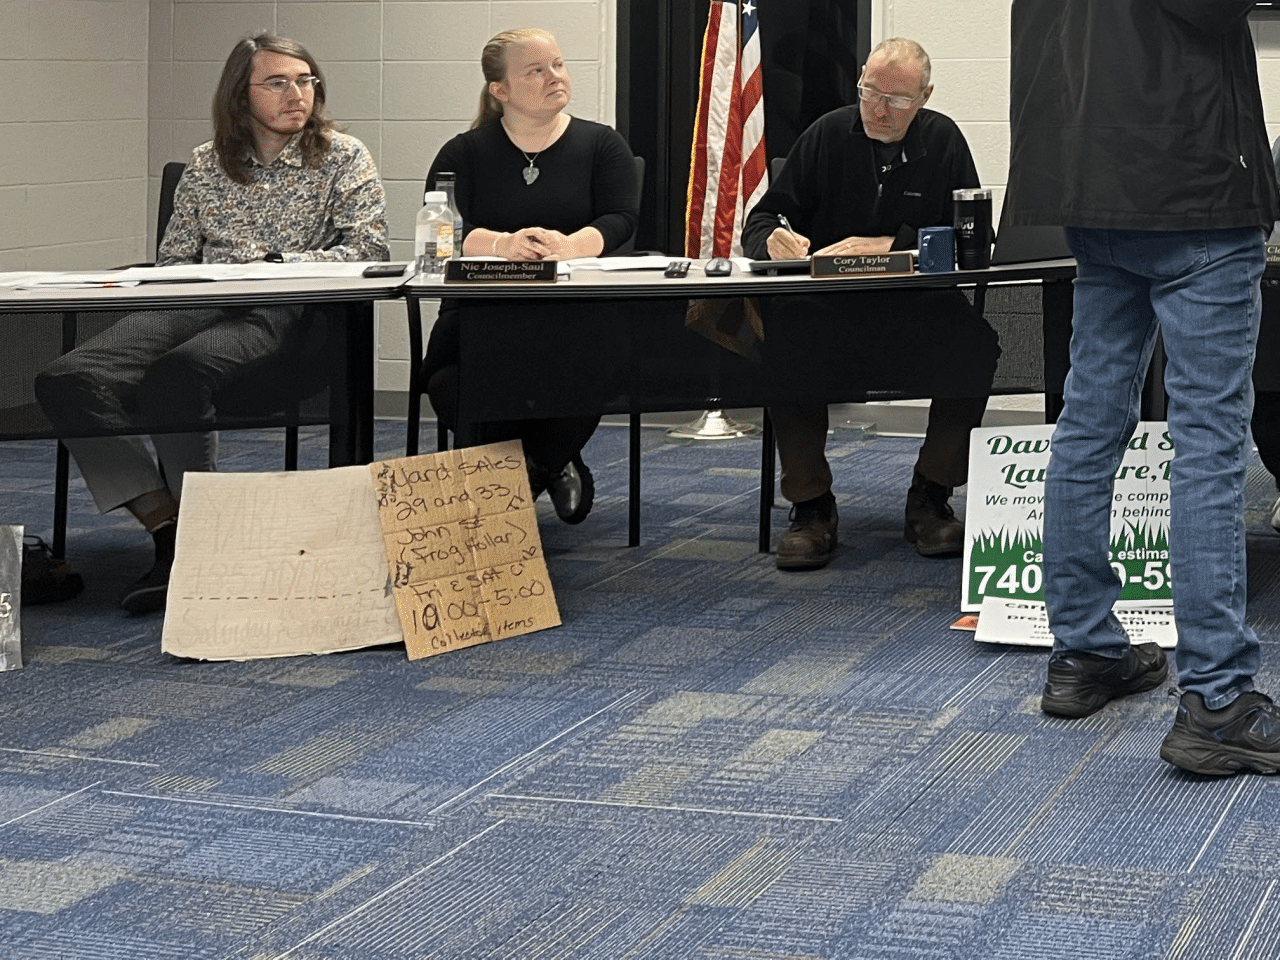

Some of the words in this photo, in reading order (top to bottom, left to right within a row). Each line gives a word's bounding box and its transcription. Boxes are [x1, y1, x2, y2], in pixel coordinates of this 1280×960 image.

[460, 262, 480, 271] Nic
[482, 262, 544, 273] Joseph-Saul
[833, 256, 857, 267] Cory
[860, 256, 891, 266] Taylor
[838, 265, 886, 274] Councilman
[466, 272, 537, 280] Councilmember
[987, 435, 1050, 455] Dav
[392, 462, 451, 496] Yard
[396, 498, 427, 520] 29
[434, 490, 469, 507] and
[475, 484, 511, 500] 33
[986, 494, 1008, 505] We
[1127, 492, 1169, 504] comp
[397, 524, 451, 544] John
[1023, 550, 1044, 563] Ca
[1117, 547, 1169, 560] estima
[974, 564, 1043, 595] 740
[409, 581, 443, 603] Fri
[0, 593, 12, 618] 5
